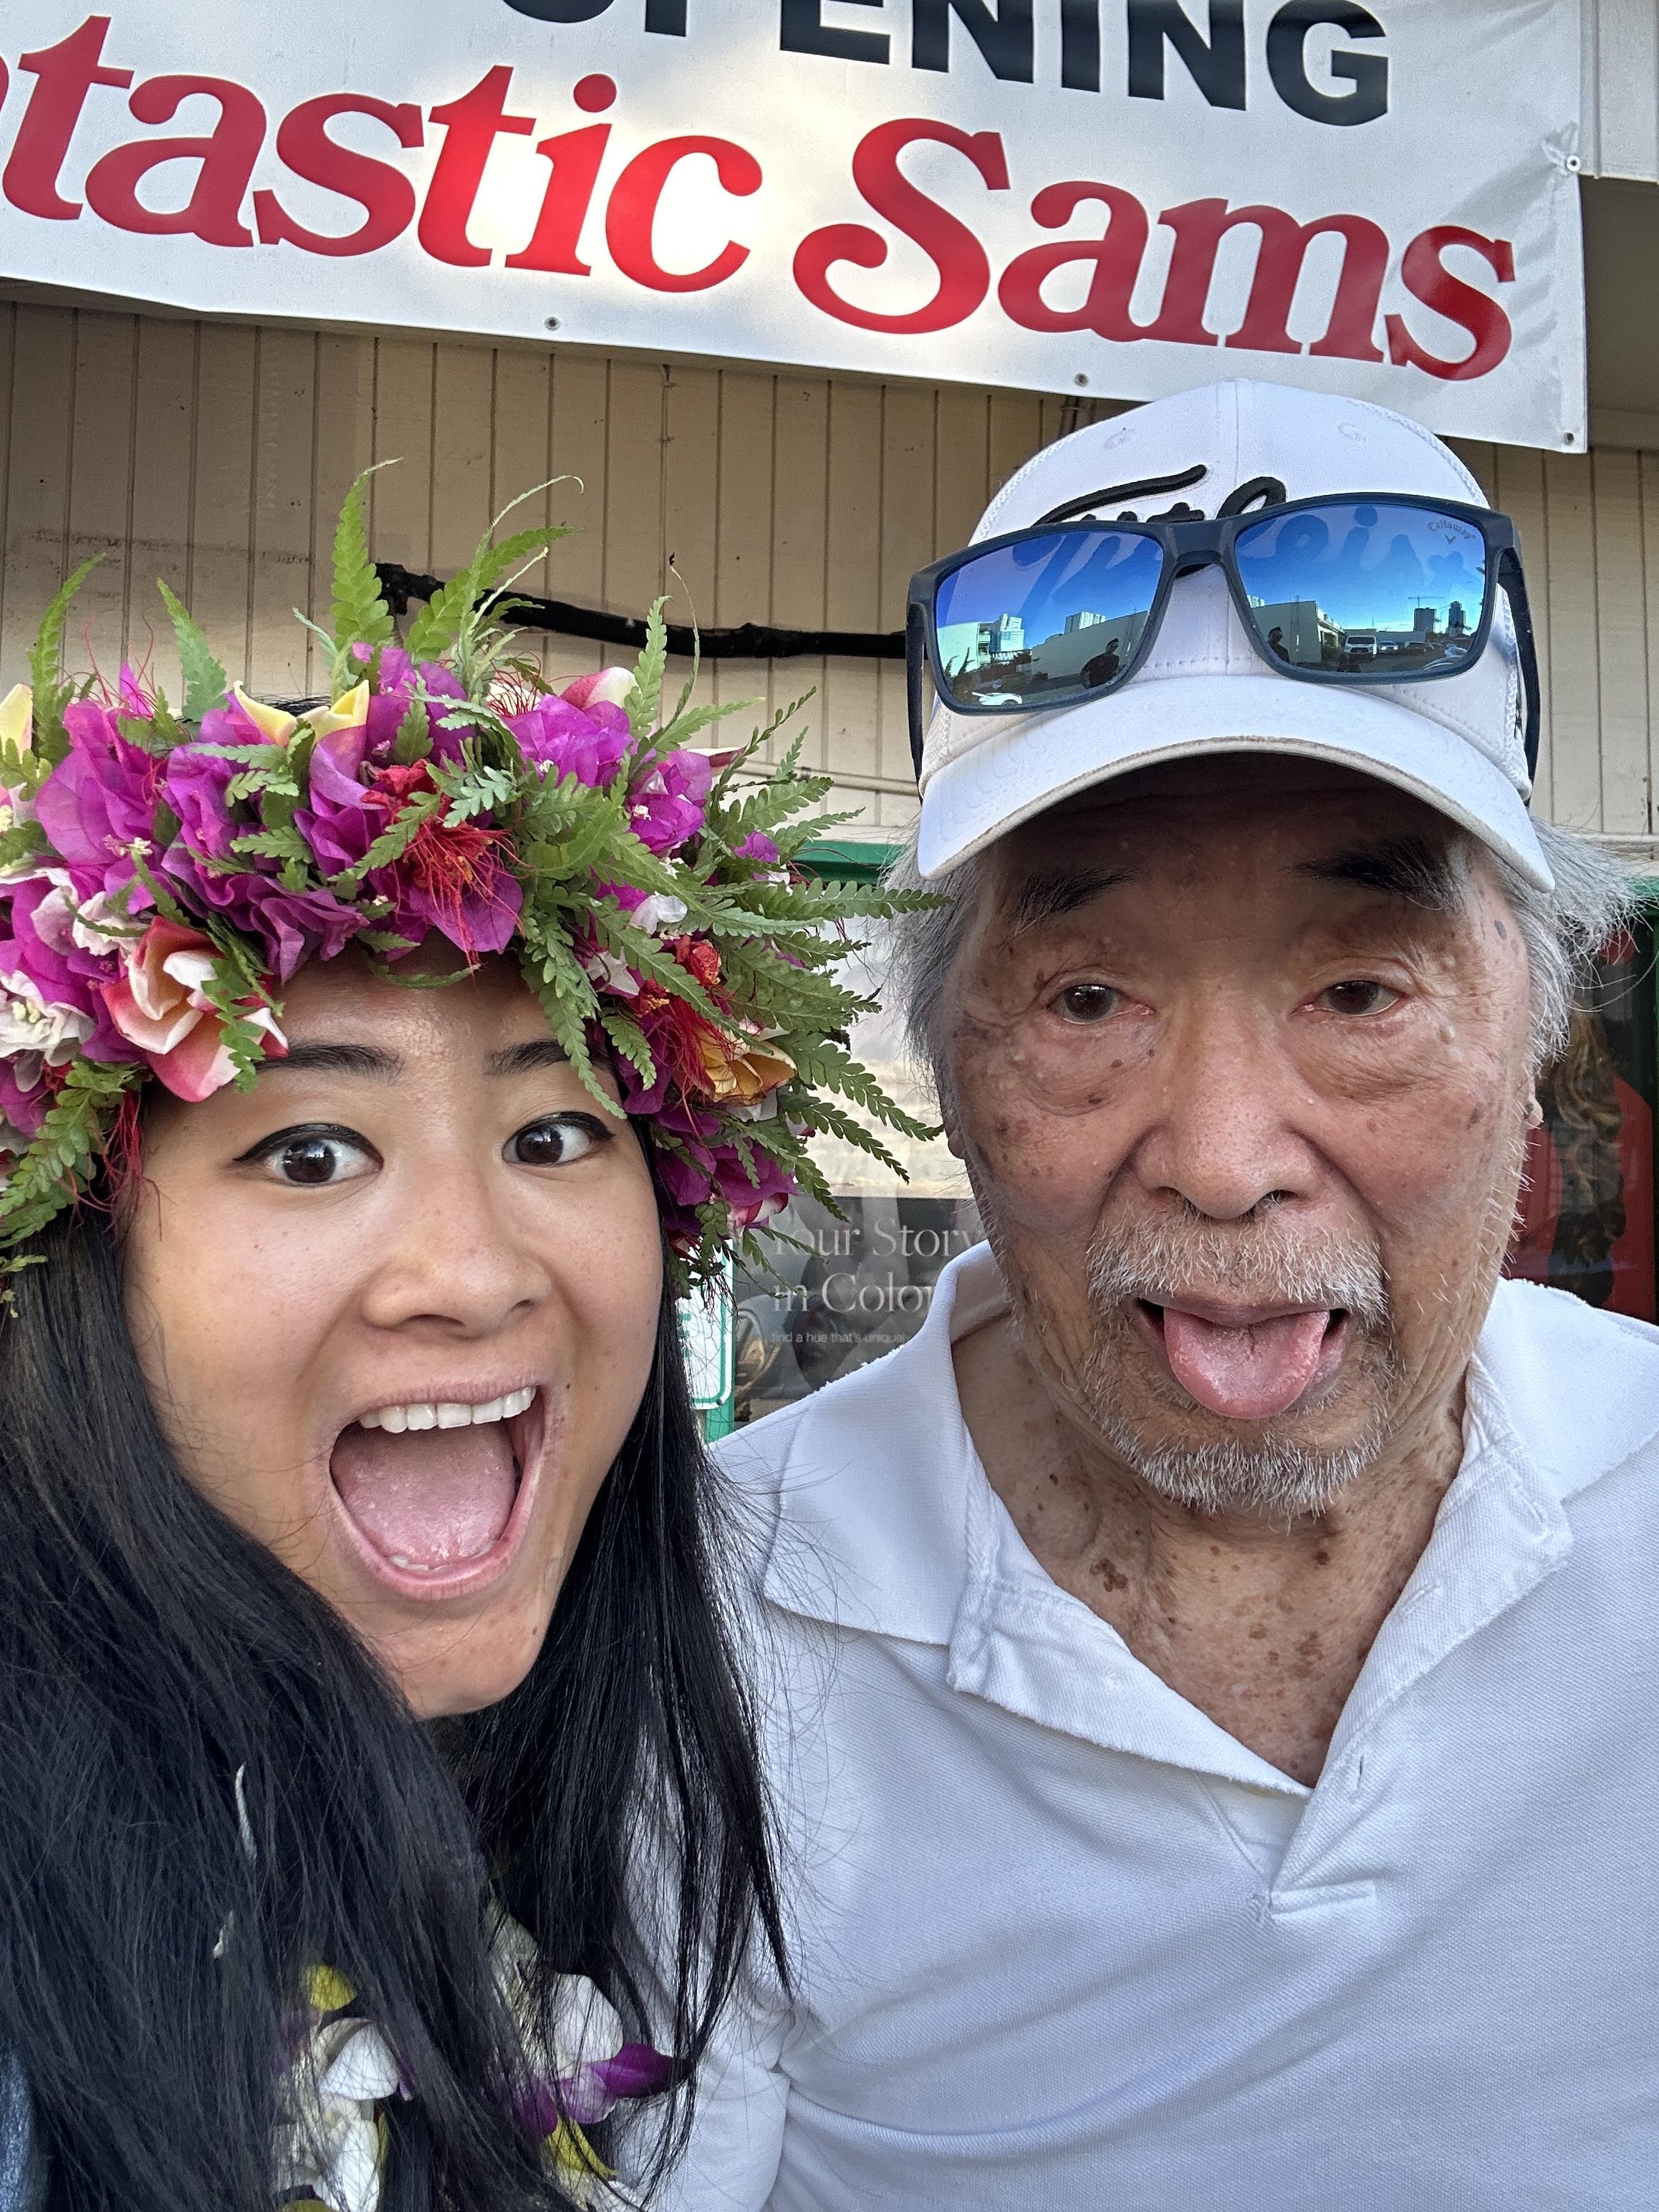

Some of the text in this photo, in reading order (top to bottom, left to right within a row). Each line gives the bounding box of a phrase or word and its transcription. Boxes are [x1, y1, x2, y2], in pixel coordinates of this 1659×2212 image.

[504, 0, 1389, 127] NING
[0, 16, 1516, 380] tastic Sams
[776, 1218, 861, 1256] our
